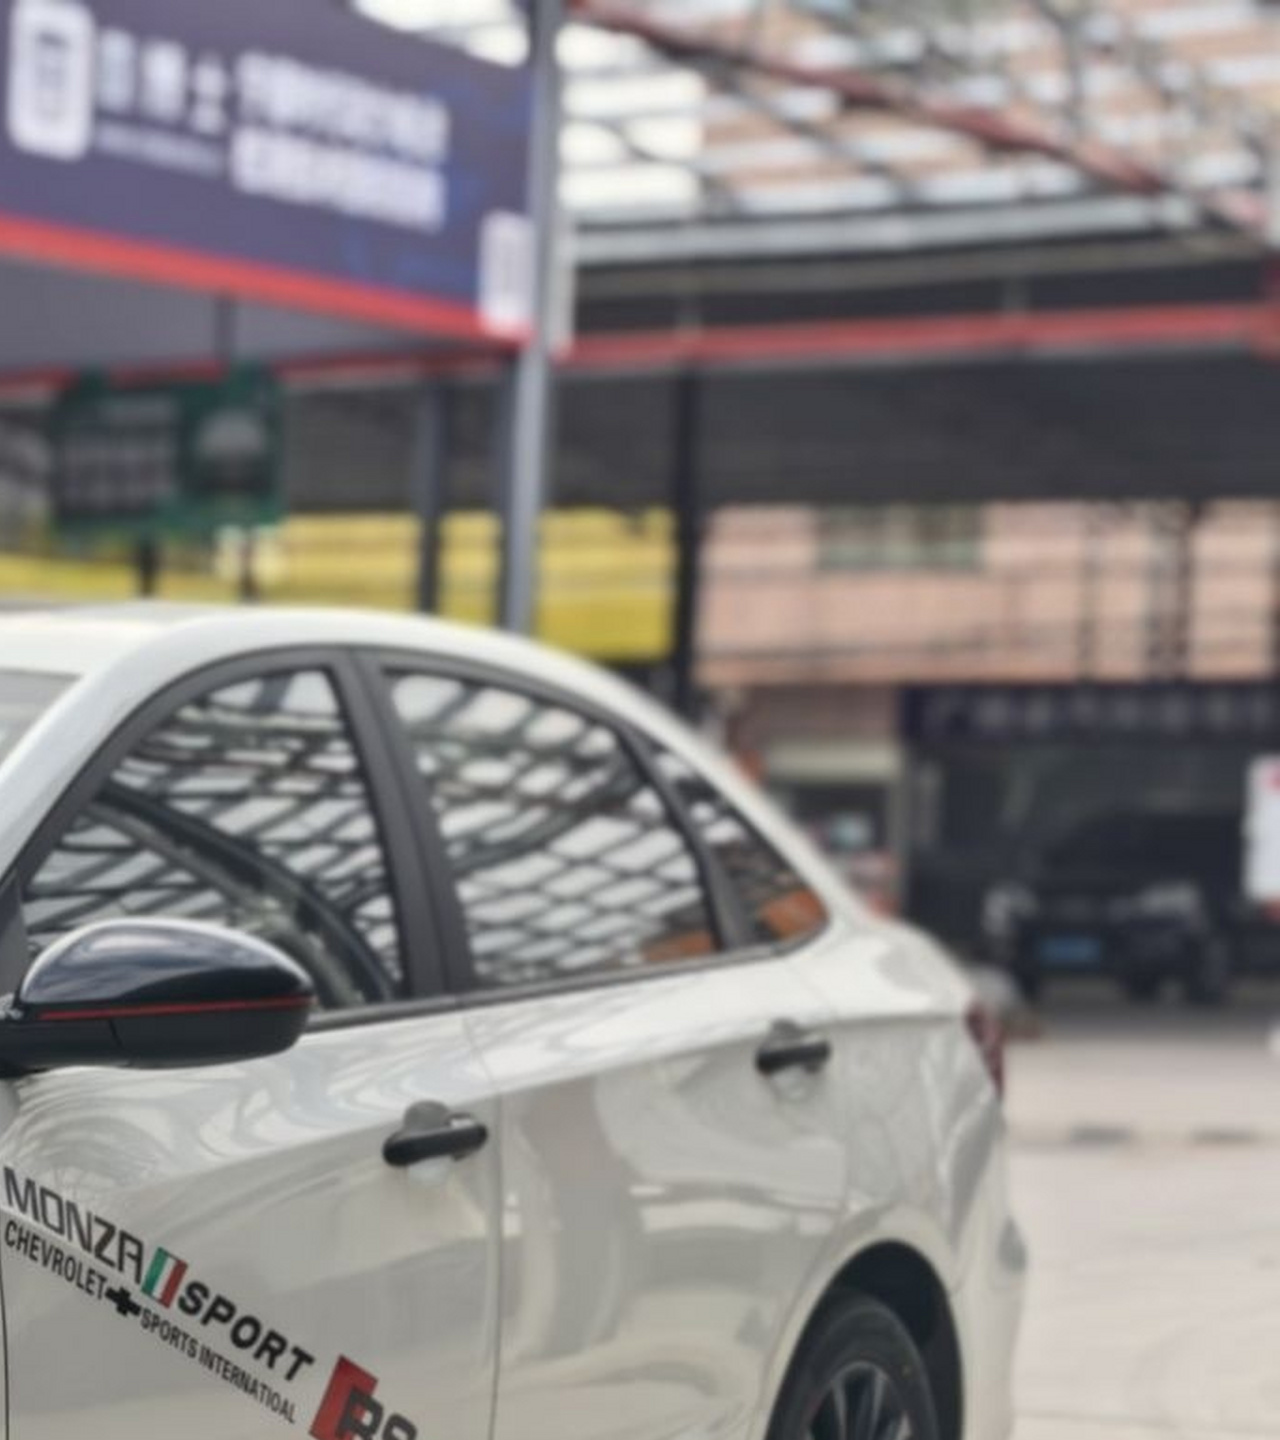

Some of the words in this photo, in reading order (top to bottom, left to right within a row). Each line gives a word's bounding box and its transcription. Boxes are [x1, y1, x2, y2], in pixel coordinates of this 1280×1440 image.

[4, 1167, 144, 1284] MONZA
[178, 1281, 315, 1381] SPORT
[5, 1220, 107, 1299] CHEVROLET
[141, 1309, 198, 1359] SPORTS
